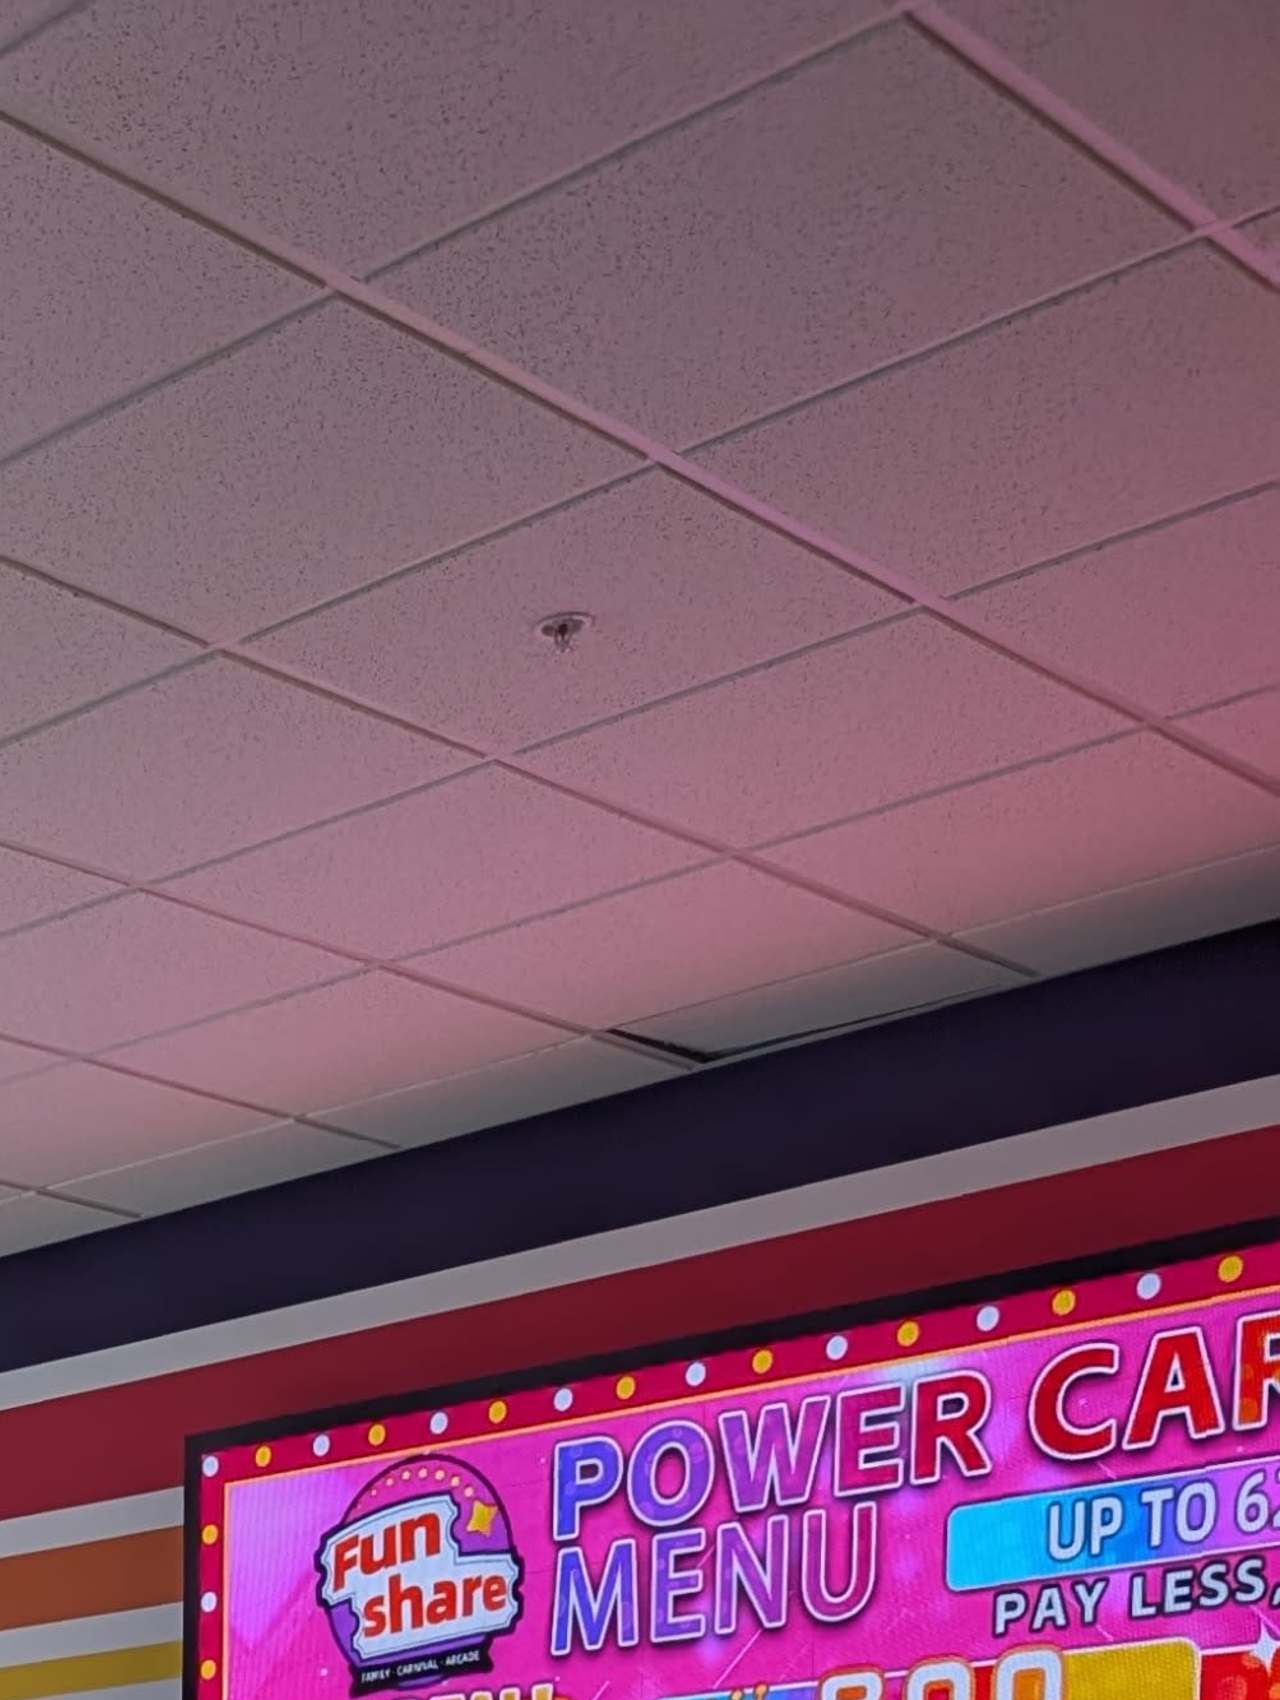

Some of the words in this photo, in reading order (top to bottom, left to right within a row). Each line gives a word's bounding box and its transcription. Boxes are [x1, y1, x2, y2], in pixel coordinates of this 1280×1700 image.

[554, 1369, 991, 1541] POWER
[333, 1512, 441, 1593] Fun
[1047, 1496, 1123, 1560] UP
[1141, 1480, 1217, 1547] TO
[362, 1573, 508, 1638] share
[551, 1503, 877, 1655] MENU
[996, 1577, 1109, 1636] PAY
[445, 1650, 481, 1667] ARCADE
